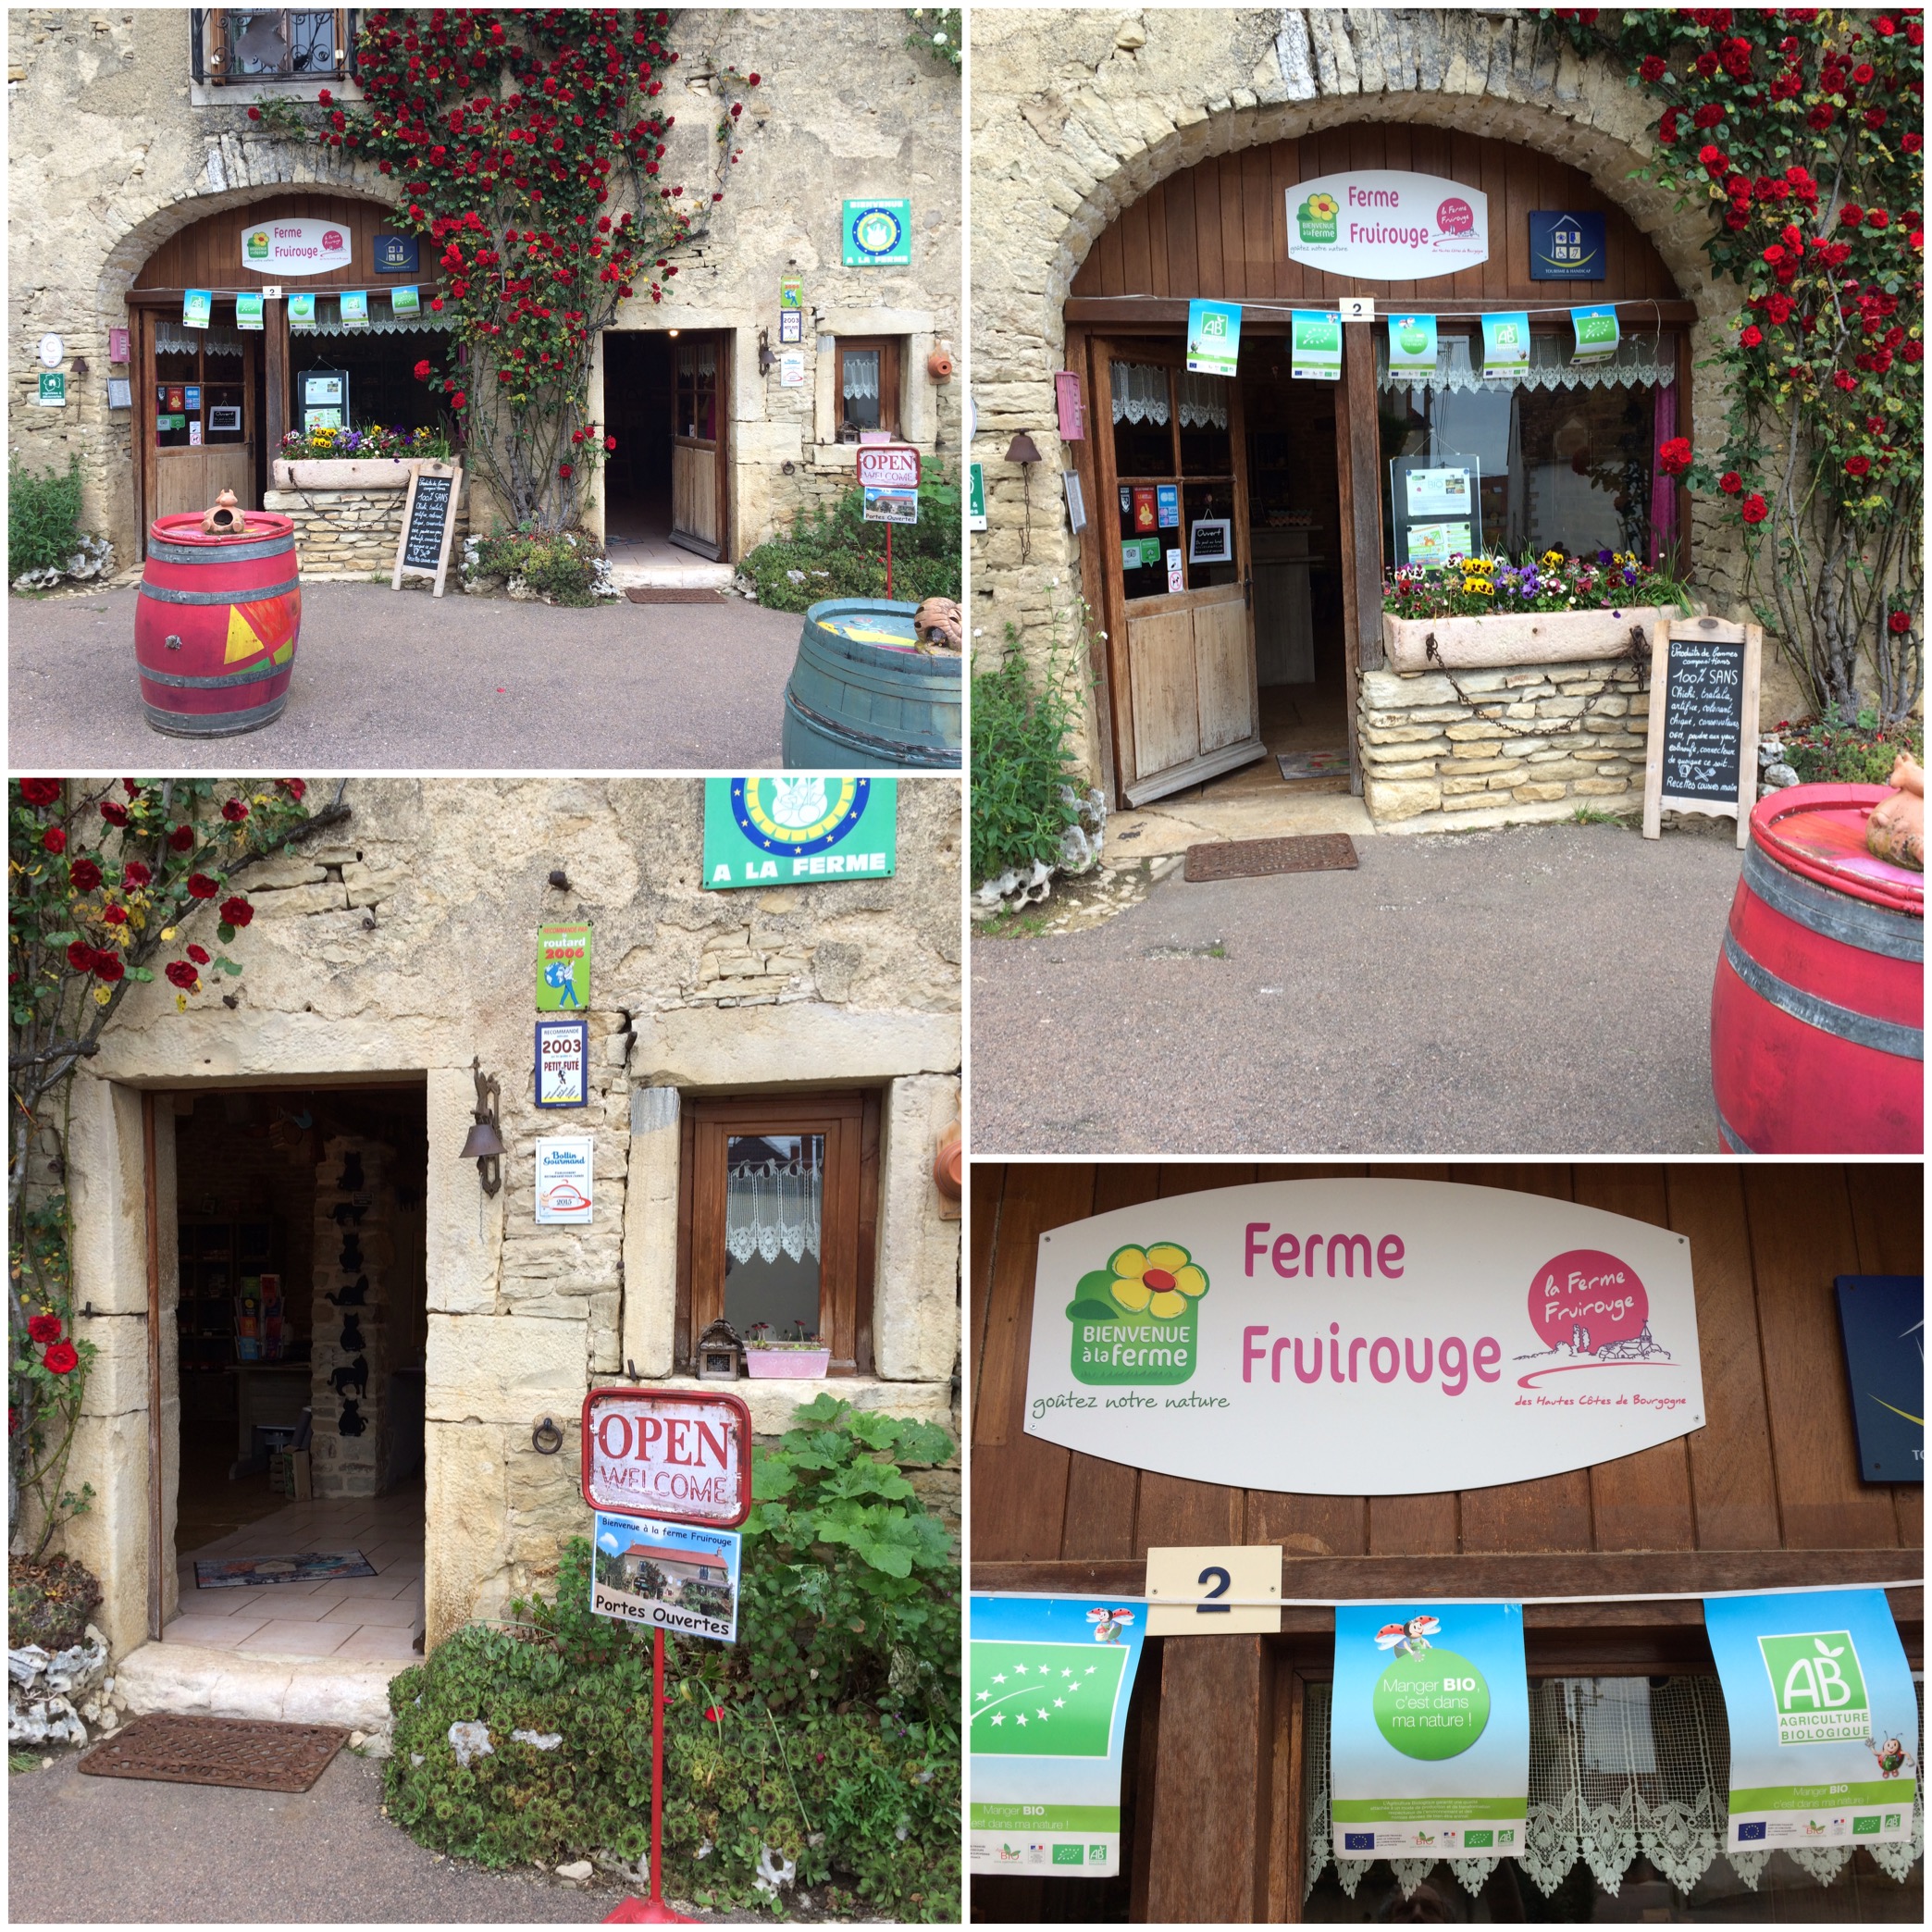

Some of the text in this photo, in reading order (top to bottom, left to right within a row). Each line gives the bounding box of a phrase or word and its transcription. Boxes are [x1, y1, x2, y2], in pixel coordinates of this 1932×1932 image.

[1348, 186, 1399, 208] Ferme
[1448, 205, 1467, 214] Ferme
[1441, 215, 1469, 225] Fruirouge
[275, 228, 302, 238] Ferme
[1311, 229, 1335, 238] ferme
[1350, 222, 1429, 249] Fruirouge
[275, 245, 317, 258] Fruirouge
[1352, 303, 1362, 317] 2
[1203, 320, 1223, 335] AB
[1497, 330, 1516, 343] AB
[863, 454, 913, 470] OPEN
[863, 471, 912, 481] WELCOME
[434, 493, 449, 502] SANS
[1197, 528, 1221, 537] Ouvert
[1671, 643, 1738, 657] Produits de bonnes
[1682, 657, 1730, 668] compositions
[1673, 667, 1738, 685] 100% SANS
[1671, 686, 1733, 702] Chichi, tralala,
[1671, 700, 1733, 715] artifice, colorant,
[1687, 731, 1708, 746] poudre
[1720, 734, 1736, 745] yeux,
[1668, 755, 1676, 763] de
[1666, 776, 1695, 789] Recettes
[1720, 783, 1737, 792] main
[712, 852, 886, 882] A LA FERME
[543, 937, 586, 947] routard
[545, 947, 585, 960] 2006
[542, 1039, 581, 1054] 2003
[544, 1059, 579, 1071] PETIT FUTÉ
[543, 1157, 585, 1166] Gourmand
[1245, 1222, 1406, 1279] Ferme
[1544, 1271, 1626, 1297] la Ferme
[1545, 1295, 1634, 1323] Fruirouge
[1083, 1326, 1191, 1344] BIENVENUE
[1083, 1344, 1188, 1367] à la ferme
[1243, 1321, 1502, 1396] Fruirouge
[1032, 1391, 1231, 1419] goûtez notre nature
[1515, 1394, 1687, 1410] des Hautes Côtes de Bourgogne
[598, 1413, 732, 1470] OPEN
[601, 1466, 727, 1505] WELCOME
[602, 1517, 732, 1547] Bienvenue à la ferme Fruirouge
[1196, 1566, 1231, 1613] 2
[596, 1595, 729, 1635] Portes Ouvertes
[1383, 1678, 1480, 1695] Manger BIO,
[1783, 1657, 1851, 1710] AB
[1395, 1695, 1469, 1710] c'est dans
[1393, 1713, 1471, 1728] ma nature !
[1780, 1713, 1869, 1728] AGRICULTURE
[1781, 1726, 1870, 1740] BIOLOGIQUE
[1793, 1785, 1851, 1798] Manger BIO,
[1773, 1800, 1795, 1809] c'est
[1797, 1798, 1820, 1808] dans
[1821, 1799, 1836, 1807] ma
[1837, 1797, 1864, 1805] nature
[983, 1805, 1047, 1817] Manger BIO,
[988, 1819, 1012, 1828] dans
[1033, 1821, 1063, 1829] nature
[1066, 1821, 1069, 1829] !
[1886, 1818, 1899, 1827] AB
[1499, 1833, 1511, 1841] AB
[1001, 1852, 1019, 1860] BIO
[1090, 1849, 1104, 1860] AB
